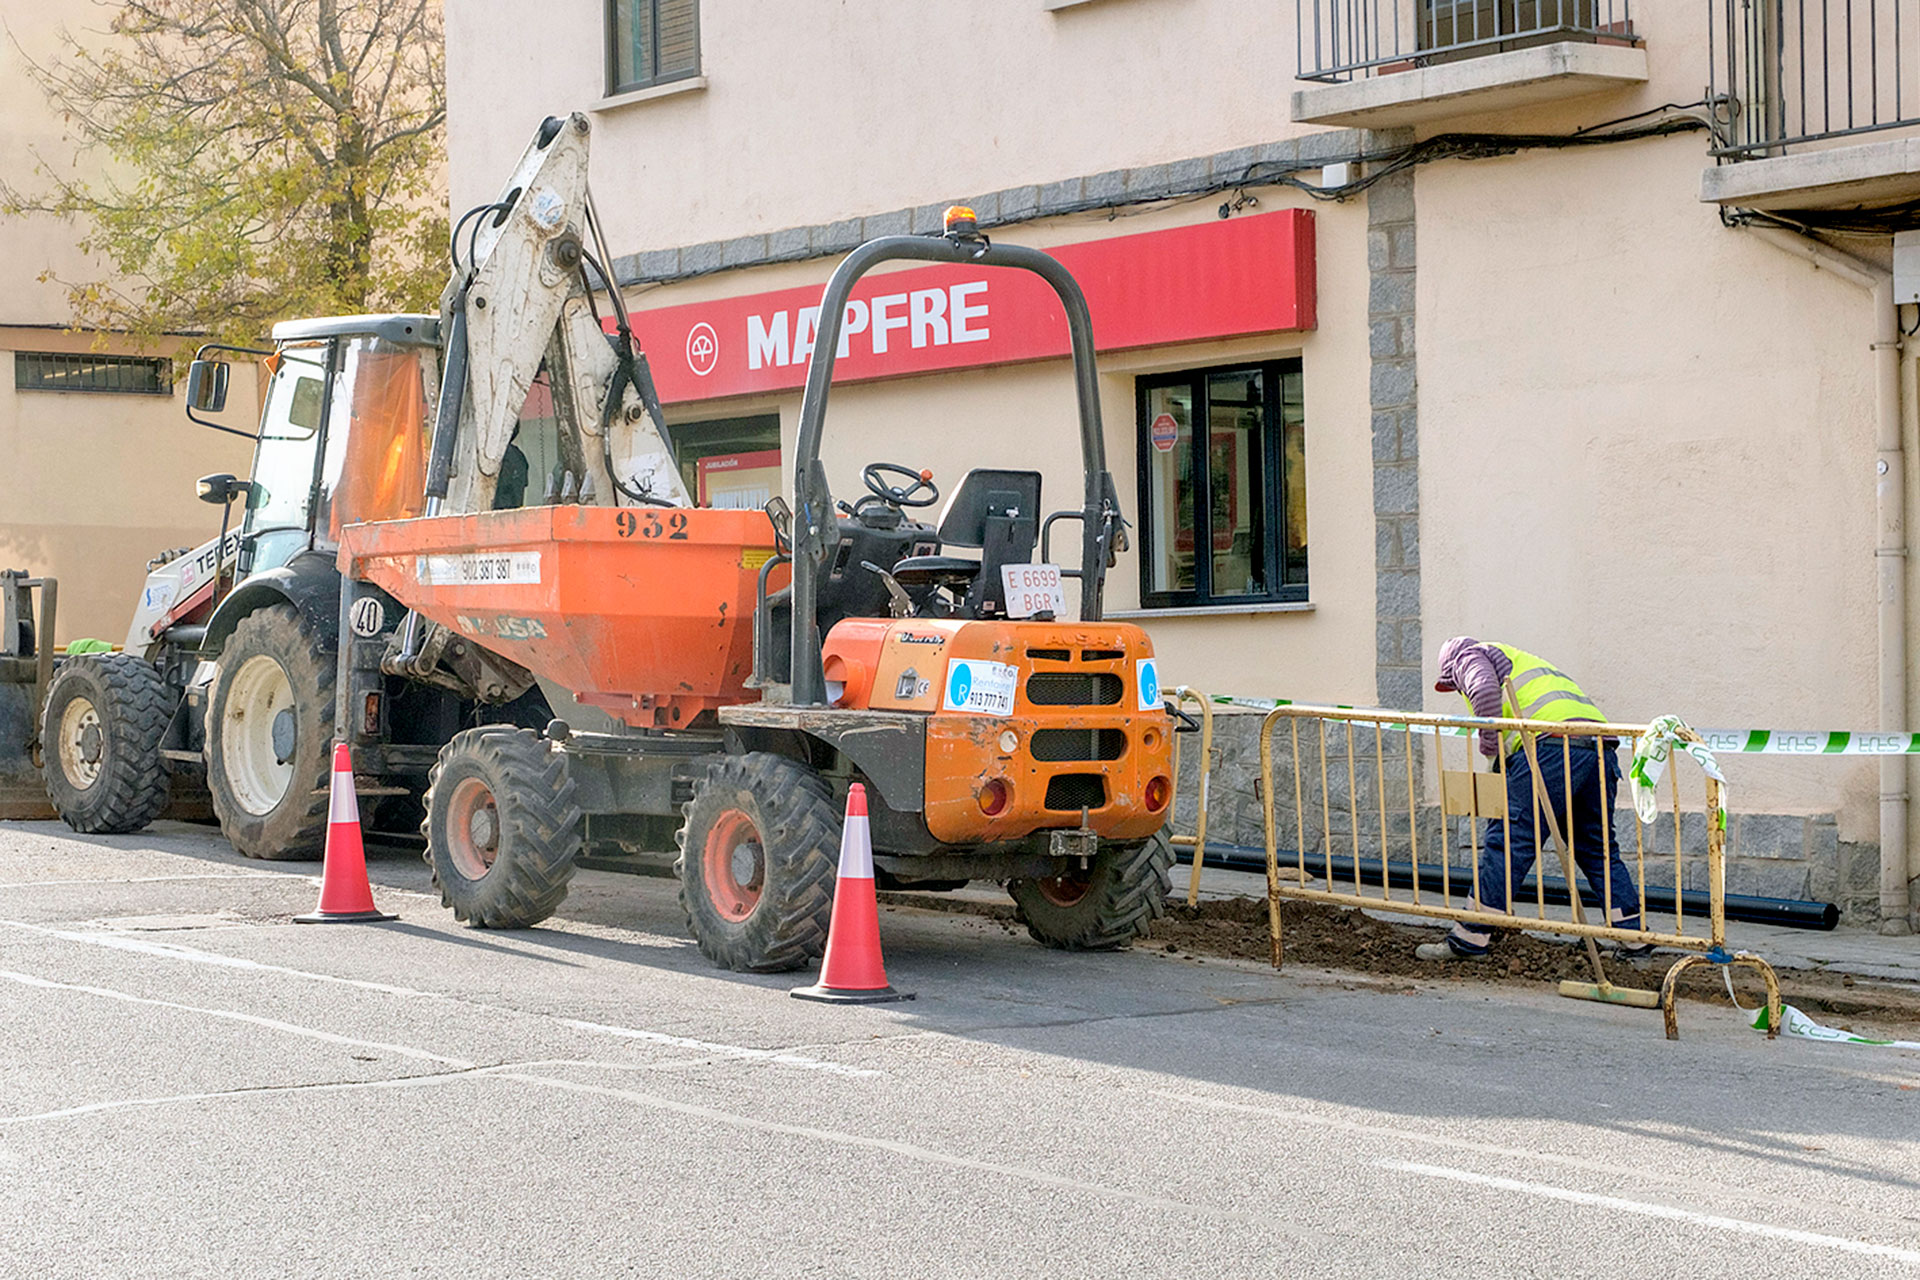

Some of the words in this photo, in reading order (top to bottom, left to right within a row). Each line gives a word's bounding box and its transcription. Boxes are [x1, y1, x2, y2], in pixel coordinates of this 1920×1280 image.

[747, 281, 990, 370] MAPFRE
[616, 511, 688, 540] 932
[479, 559, 494, 580] 387
[496, 558, 511, 579] 387
[1008, 571, 1018, 589] E
[1023, 570, 1057, 588] 6699
[1023, 593, 1052, 612] BGR
[357, 601, 377, 633] 40
[958, 684, 968, 702] R
[984, 693, 997, 708] 777
